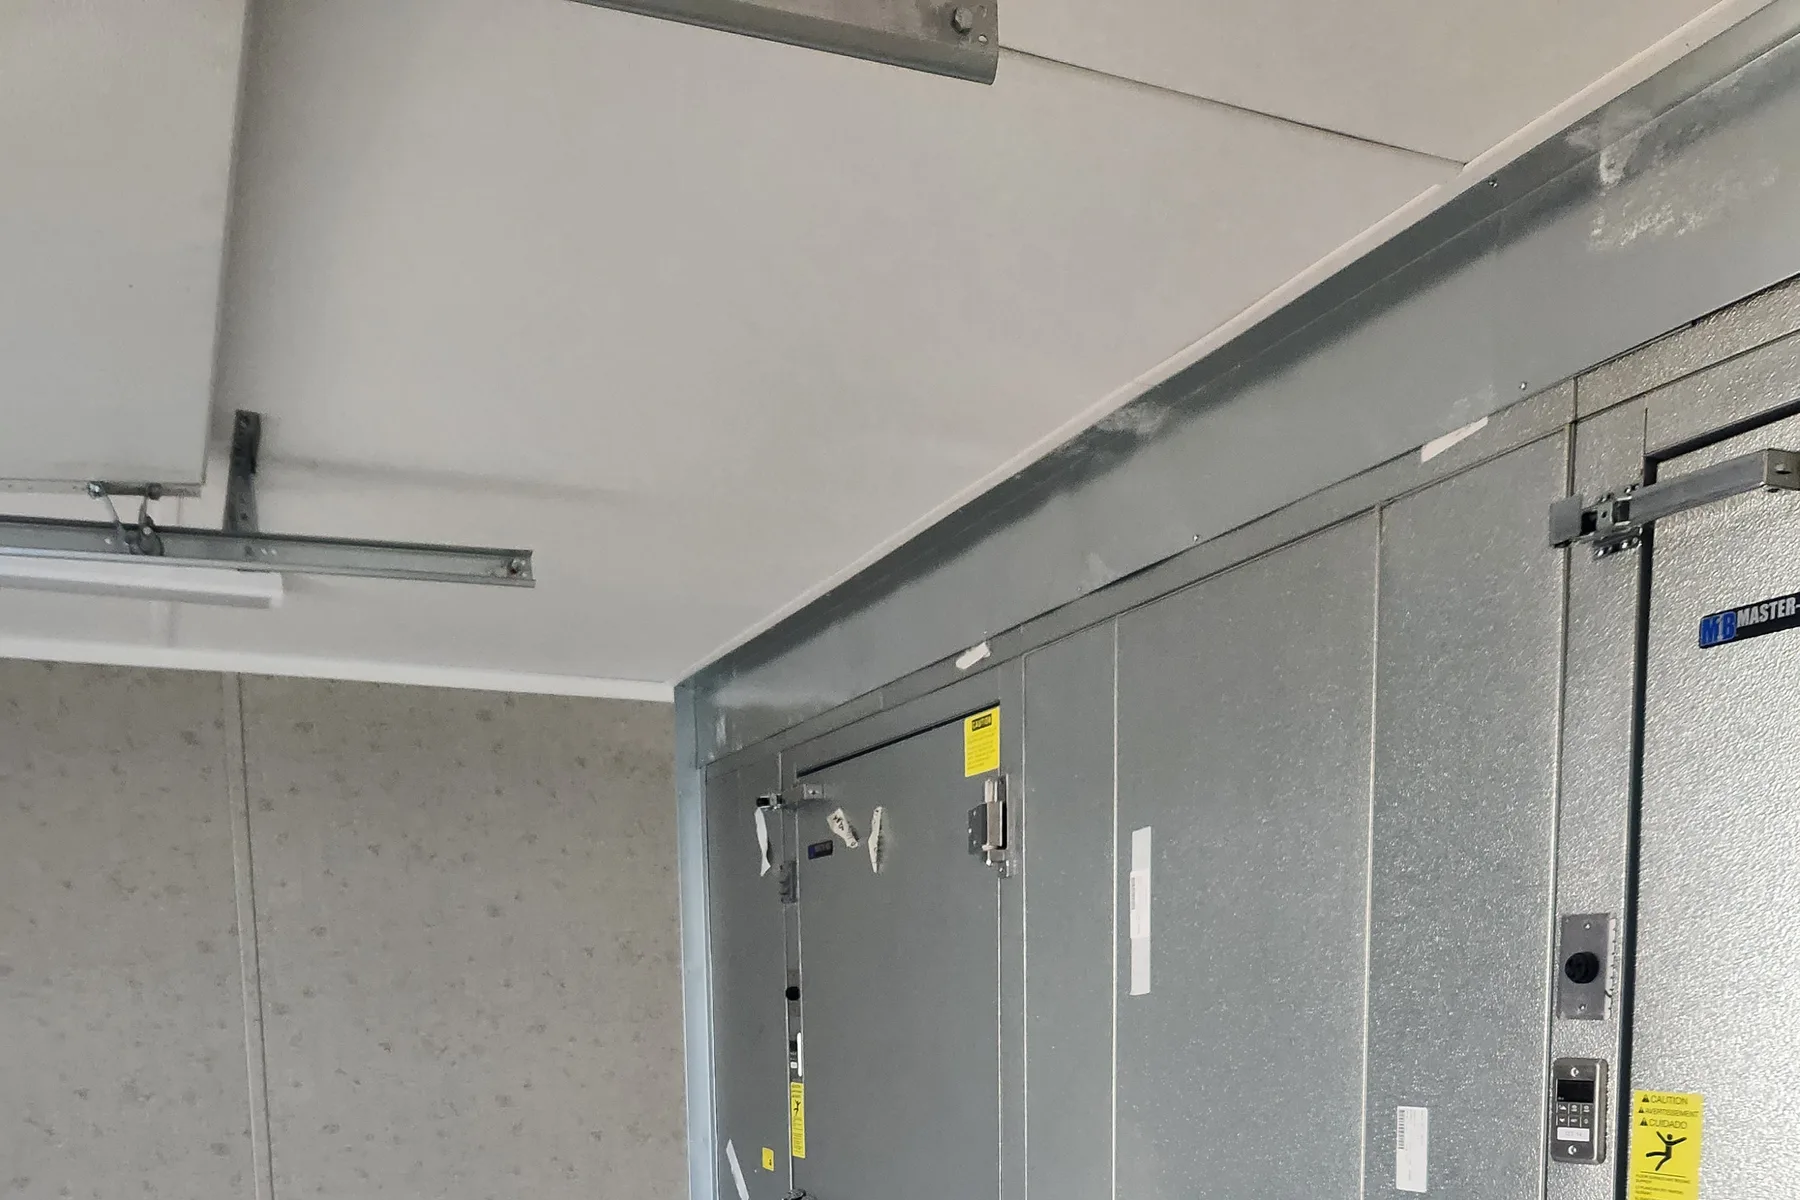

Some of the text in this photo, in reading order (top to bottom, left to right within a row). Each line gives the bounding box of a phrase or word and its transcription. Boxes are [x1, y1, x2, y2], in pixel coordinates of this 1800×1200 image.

[1650, 1094, 1688, 1105] CAUTION
[1645, 1107, 1699, 1117] AVERTISSEMENT
[1649, 1118, 1687, 1129] CUIDADO
